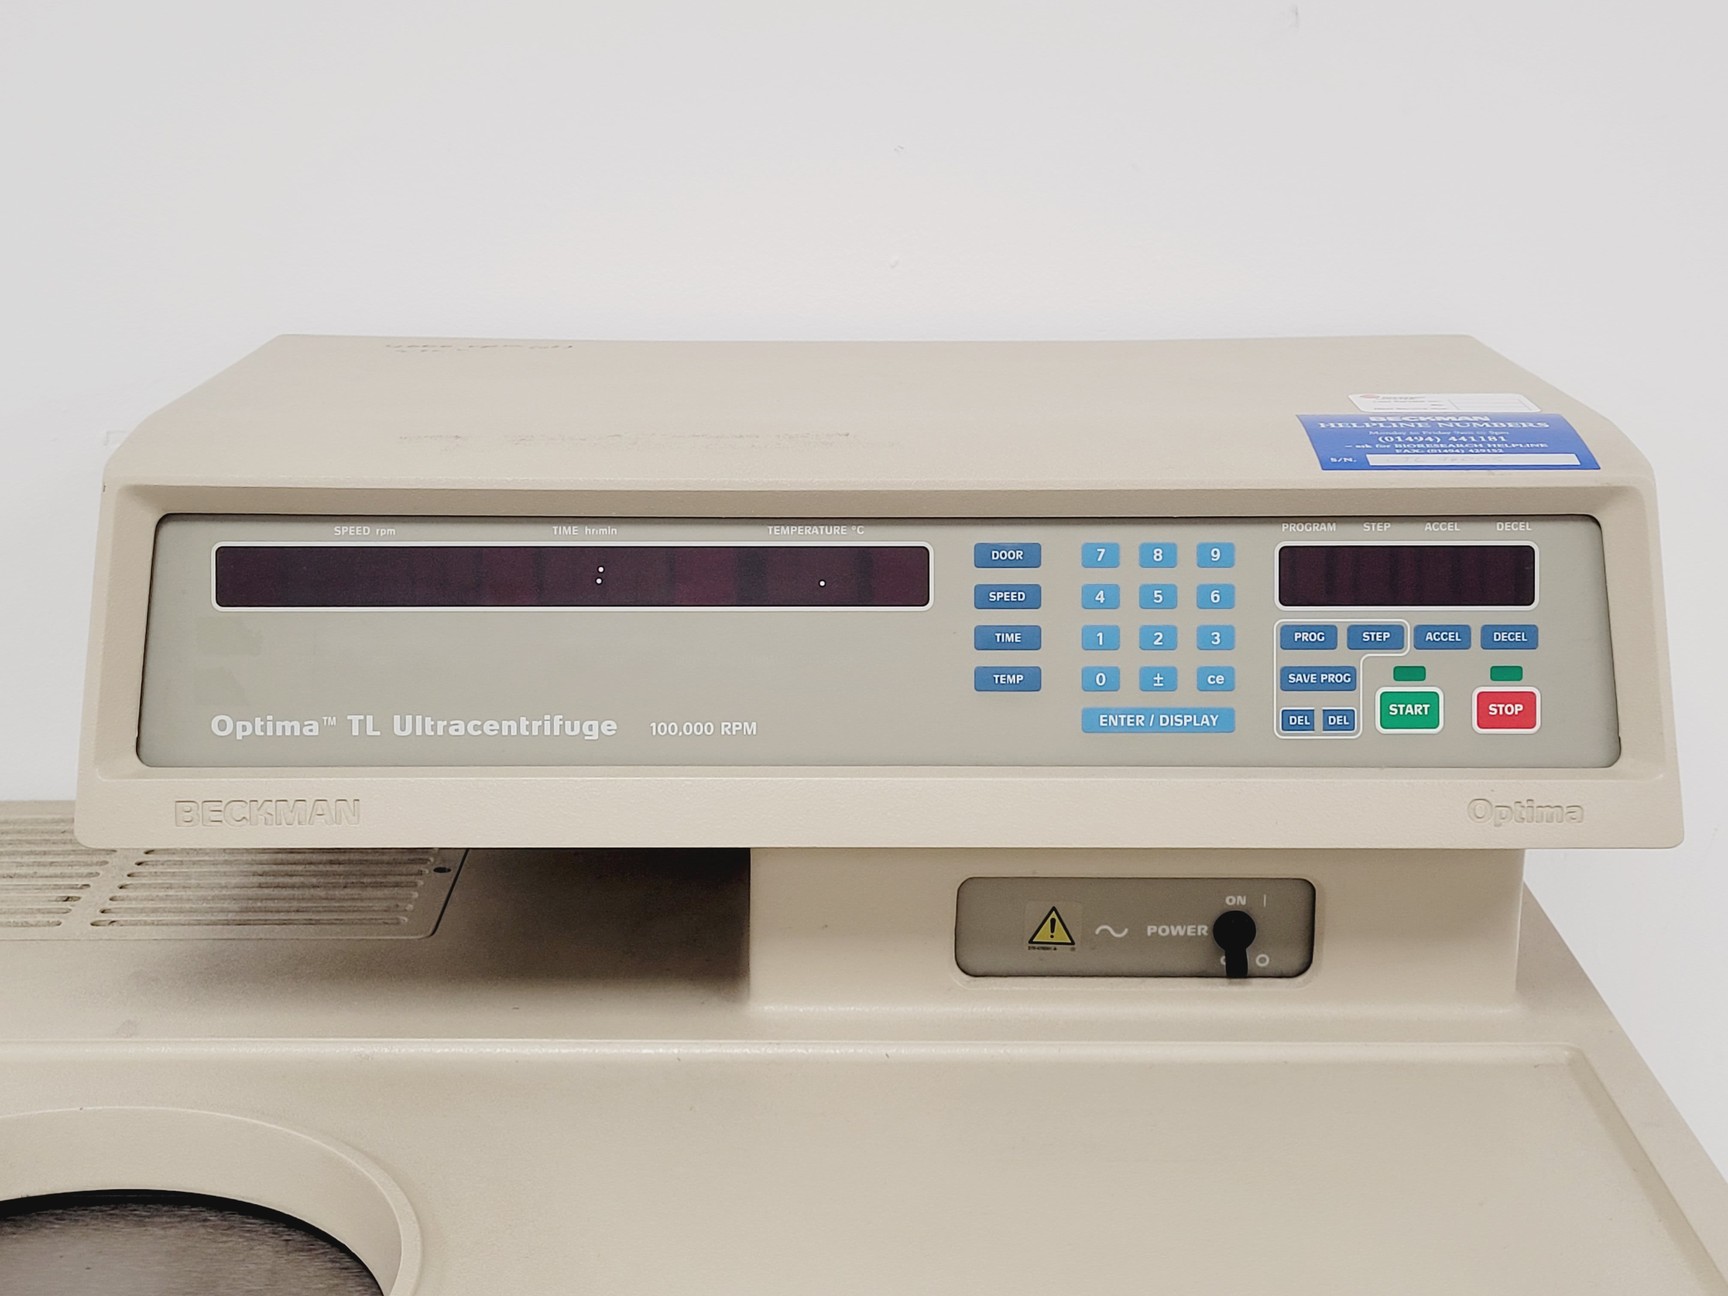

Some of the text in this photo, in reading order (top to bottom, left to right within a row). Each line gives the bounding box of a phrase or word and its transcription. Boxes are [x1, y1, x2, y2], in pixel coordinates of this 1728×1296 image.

[334, 526, 396, 537] SPEED rpm
[552, 526, 579, 535] TIME
[767, 525, 865, 535] TEMPERATURE °C
[1281, 522, 1337, 532] PROGRAM
[1363, 522, 1391, 532] STEP
[1424, 522, 1461, 532] ACCEL
[1496, 521, 1532, 531] DECEL
[991, 550, 1024, 560] DOOR
[1097, 548, 1106, 562] 7
[1153, 548, 1163, 562] 8
[1210, 548, 1220, 562] 9
[988, 591, 1026, 602] SPEED
[1095, 590, 1105, 603] 4
[1153, 590, 1163, 603] 5
[1210, 590, 1220, 603] 6
[995, 632, 1022, 643] TIME
[1096, 632, 1103, 646] 1
[1153, 632, 1163, 646] 2
[1211, 632, 1221, 646] 3
[1294, 632, 1325, 642] PROG
[1362, 632, 1391, 642] STEP
[1425, 632, 1462, 642] ACCEL
[1493, 632, 1528, 642] DECEL
[993, 674, 1024, 685] TEMP
[1096, 673, 1106, 686] 0
[1207, 674, 1225, 685] ce
[1288, 673, 1351, 684] SAVE PROG
[1389, 703, 1430, 716] START
[1488, 703, 1523, 716] STOP
[1099, 714, 1145, 727] ENTER
[1159, 714, 1219, 727] DISPLAY
[1289, 715, 1311, 726] DEL
[1328, 715, 1349, 726] DEL
[347, 715, 381, 736] TL
[393, 714, 618, 740] Ultracentrifuge
[650, 722, 714, 737] 100,000
[720, 722, 757, 735] RPM
[175, 799, 360, 828] BECKMAN
[1467, 798, 1584, 827] Optima
[1225, 895, 1247, 906] ON
[1147, 925, 1209, 936] POWER
